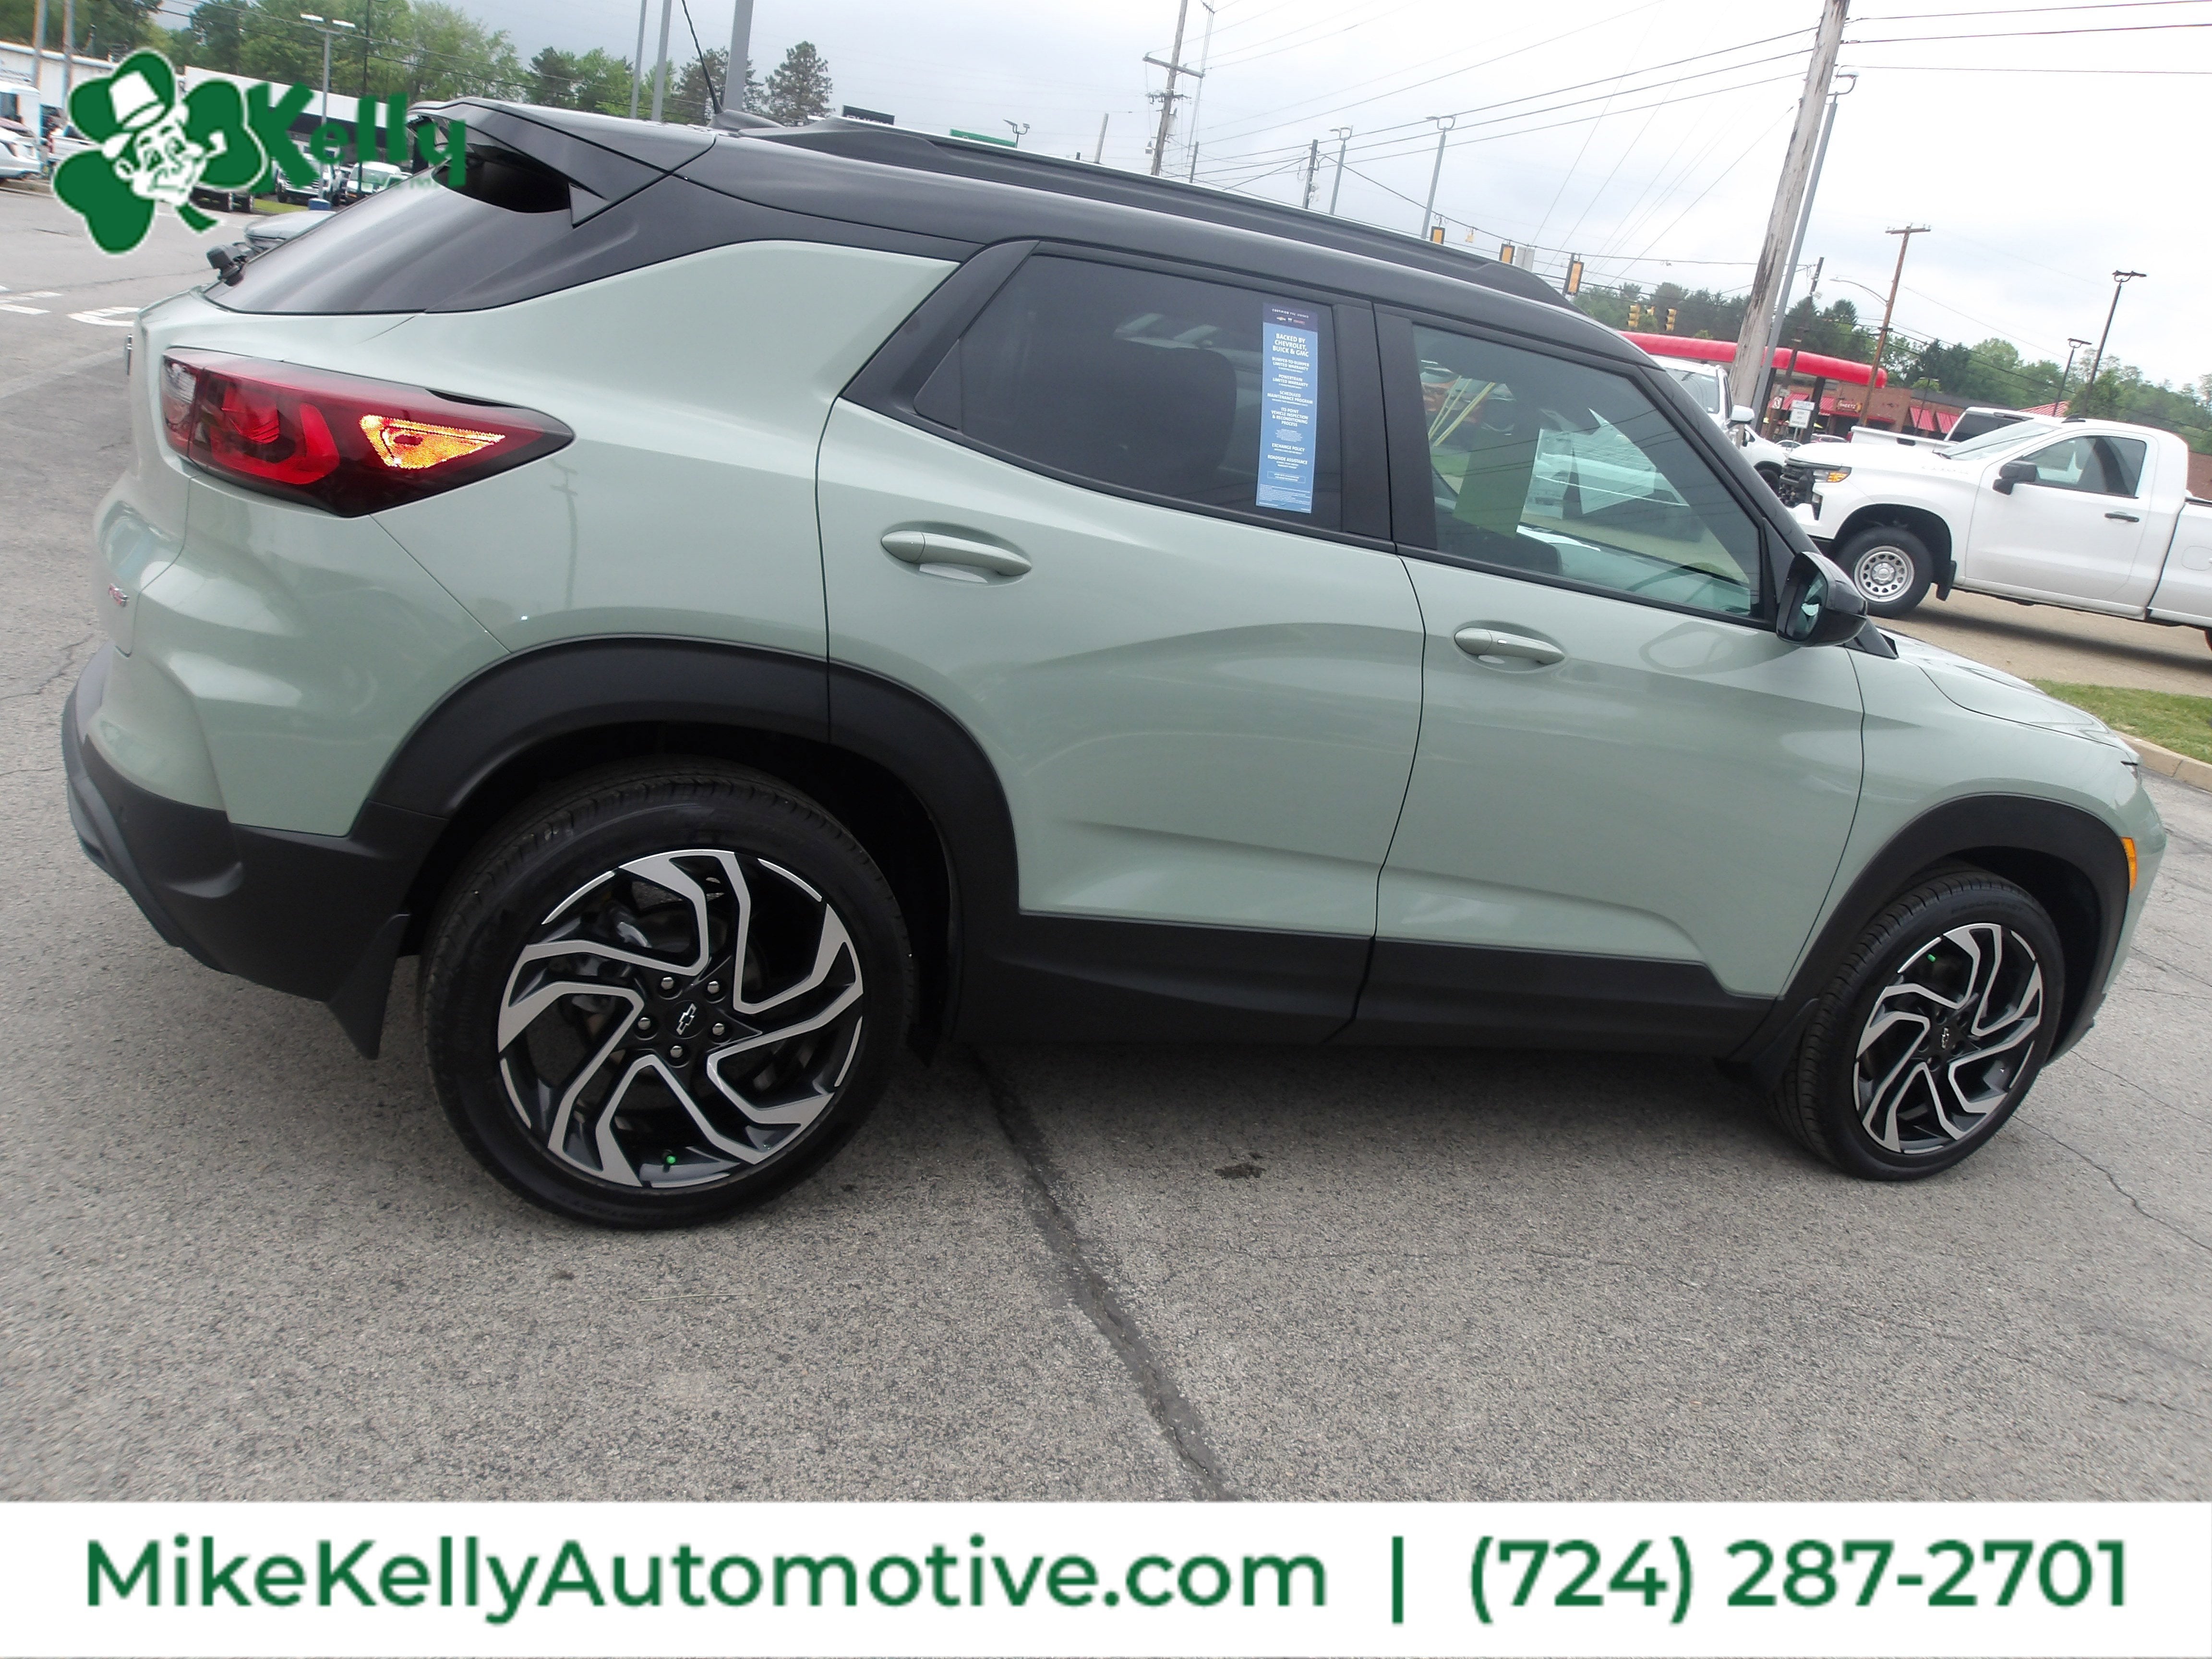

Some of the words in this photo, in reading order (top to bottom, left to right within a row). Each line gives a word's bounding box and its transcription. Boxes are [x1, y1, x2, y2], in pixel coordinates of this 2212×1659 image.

[1276, 333, 1298, 342] BACKED
[1272, 345, 1289, 354] BUICK
[1274, 339, 1307, 351] CHEVROLET,
[1288, 363, 1309, 372] WARRANTY
[1278, 374, 1303, 382] POWERTRAIN
[1267, 393, 1294, 401] MAINTENANCE
[1276, 415, 1308, 425] RECONDITIONING
